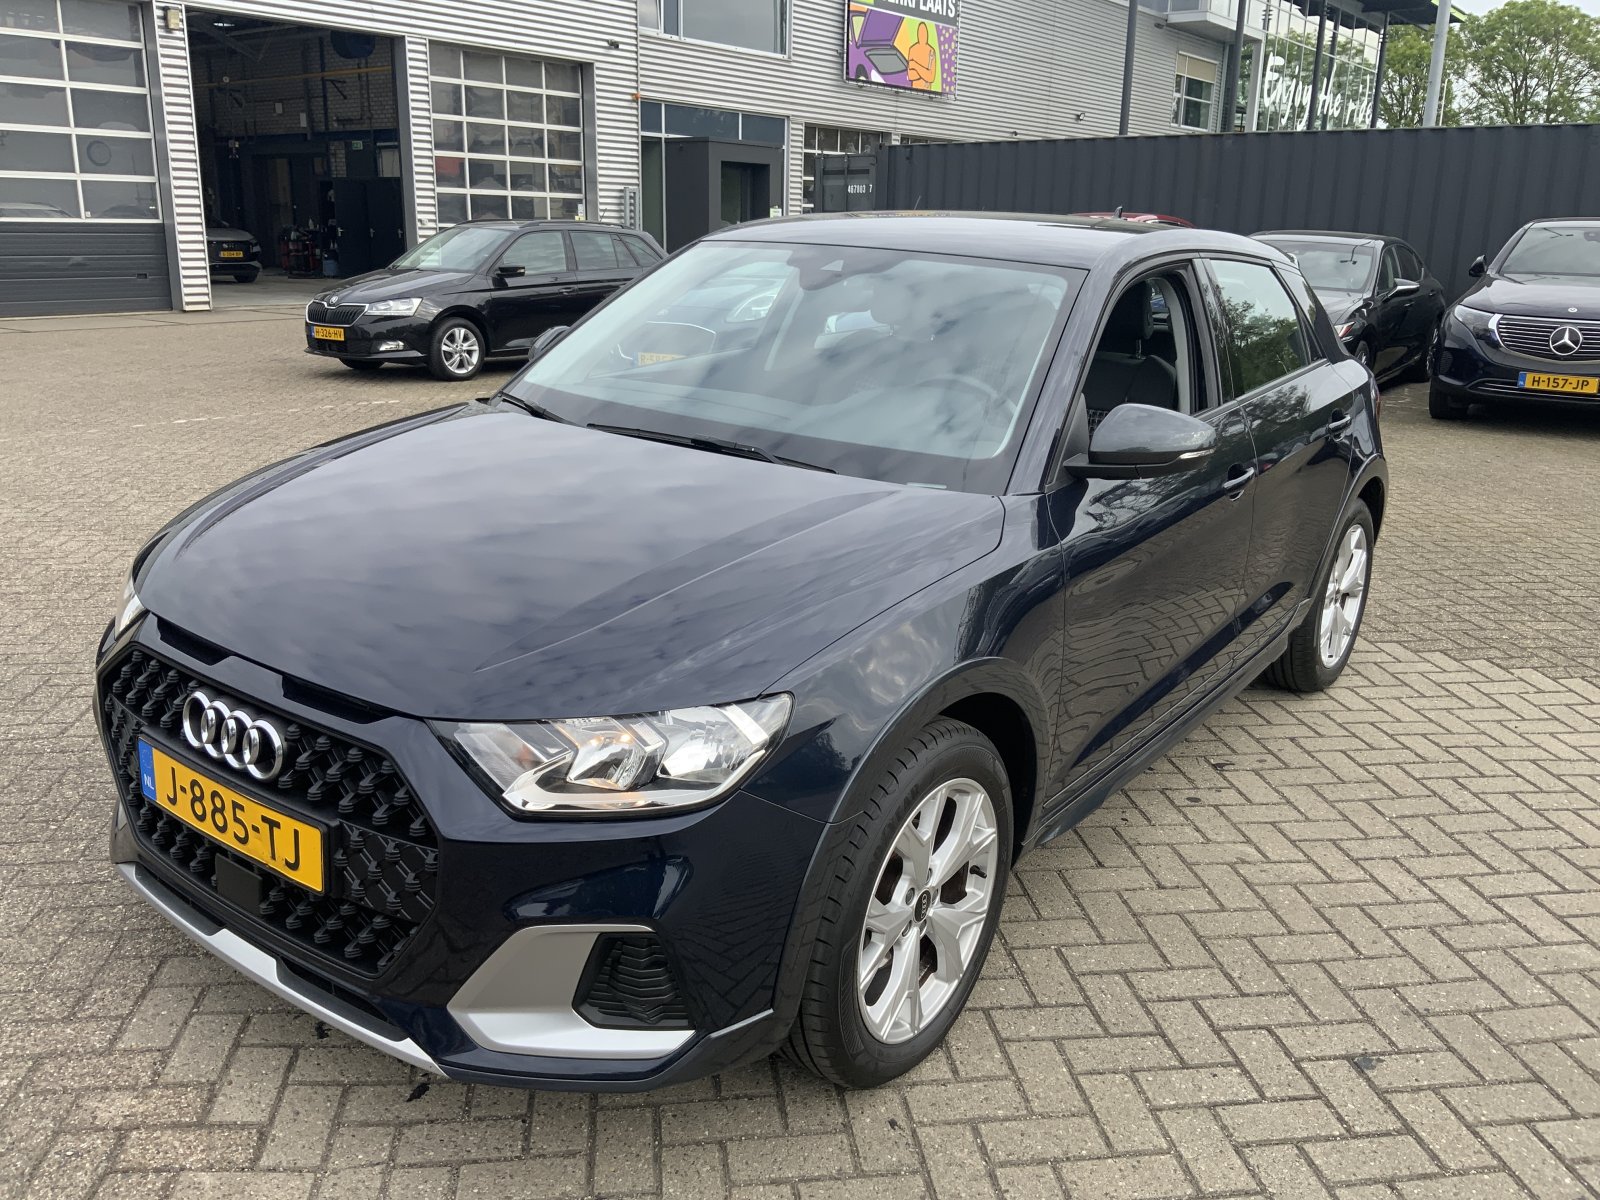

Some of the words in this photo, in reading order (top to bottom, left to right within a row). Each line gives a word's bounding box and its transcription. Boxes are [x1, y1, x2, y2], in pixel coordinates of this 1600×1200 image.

[1263, 51, 1313, 131] Enjoy
[1316, 62, 1342, 118] the
[1345, 73, 1373, 126] ride
[869, 184, 873, 193] 7
[315, 328, 342, 339] H-326-HV
[1532, 375, 1590, 391] H-157-JP
[144, 774, 155, 790] NL
[166, 766, 301, 872] J-885-TJ
